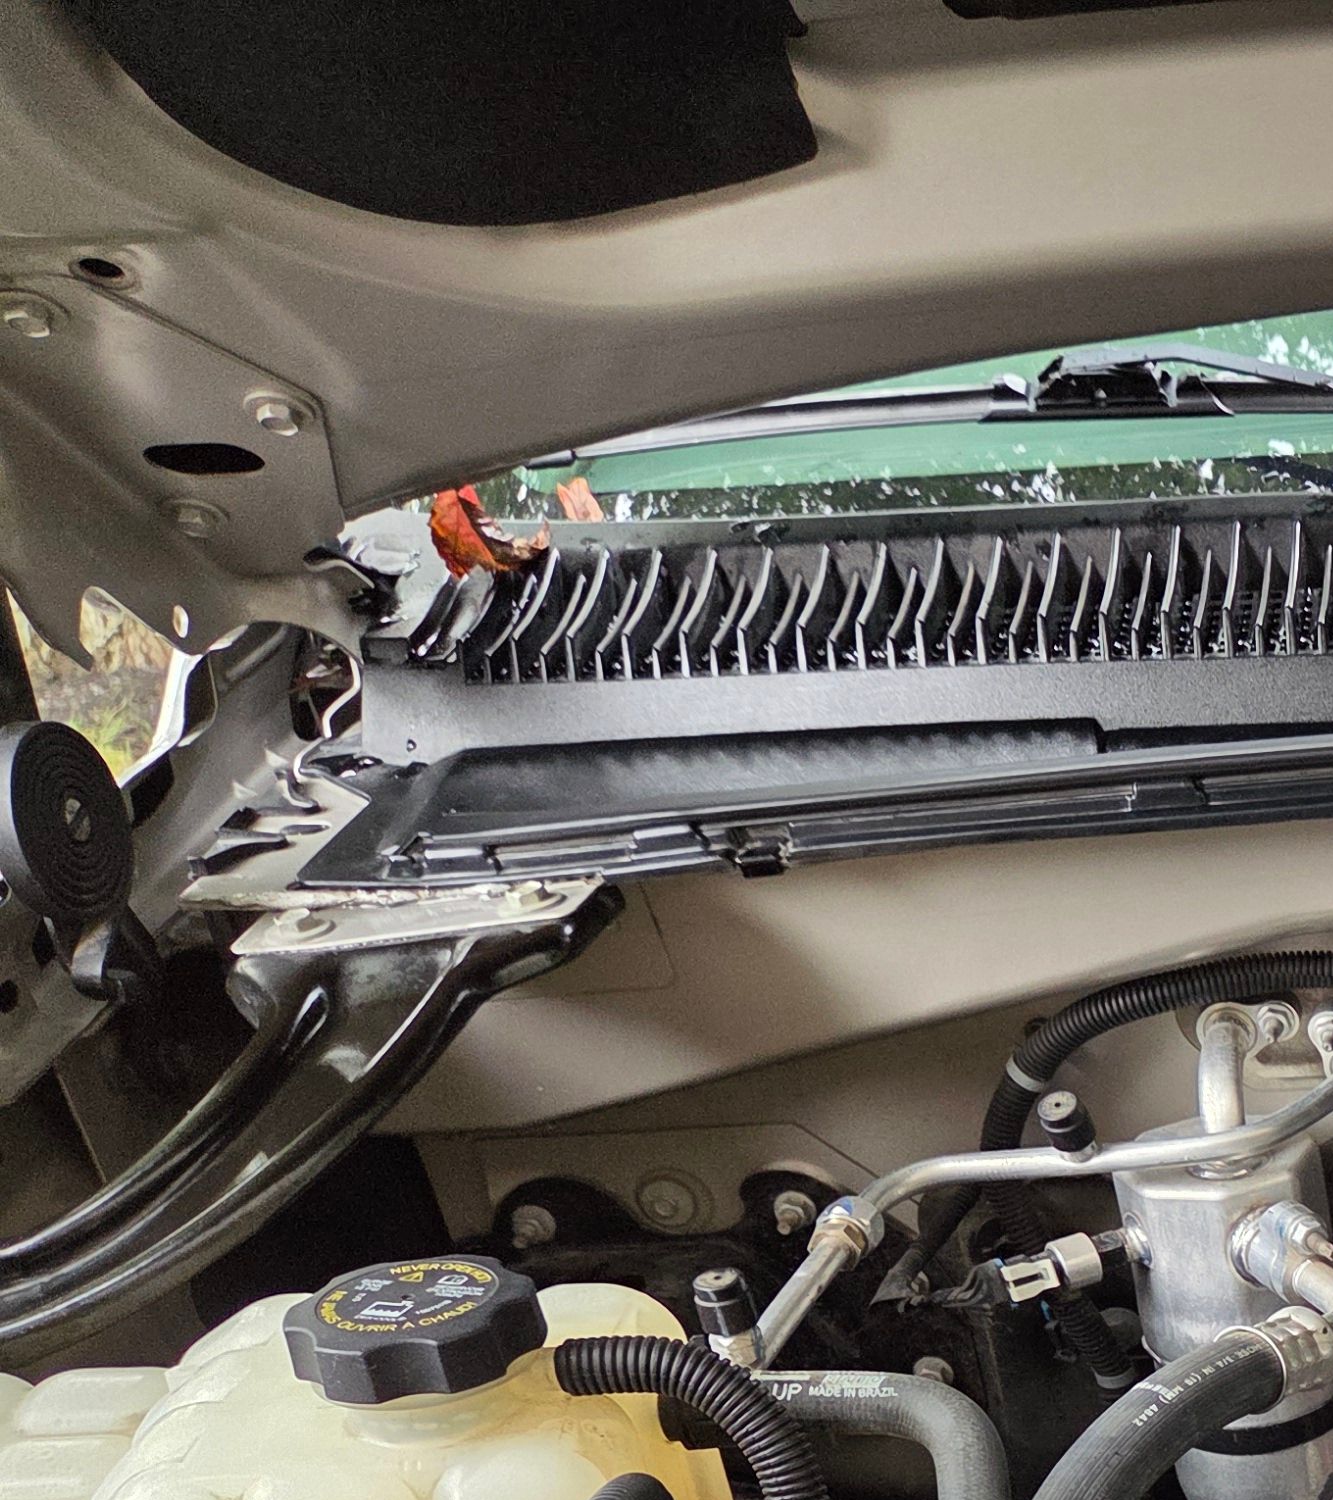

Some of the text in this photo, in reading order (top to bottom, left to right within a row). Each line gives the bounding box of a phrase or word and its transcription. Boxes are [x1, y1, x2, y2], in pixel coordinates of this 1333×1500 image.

[390, 1263, 439, 1274] NEVER
[336, 1319, 397, 1332] OUVRIR
[772, 1383, 803, 1401] UP
[809, 1385, 899, 1398] MADE IN BRAZIL
